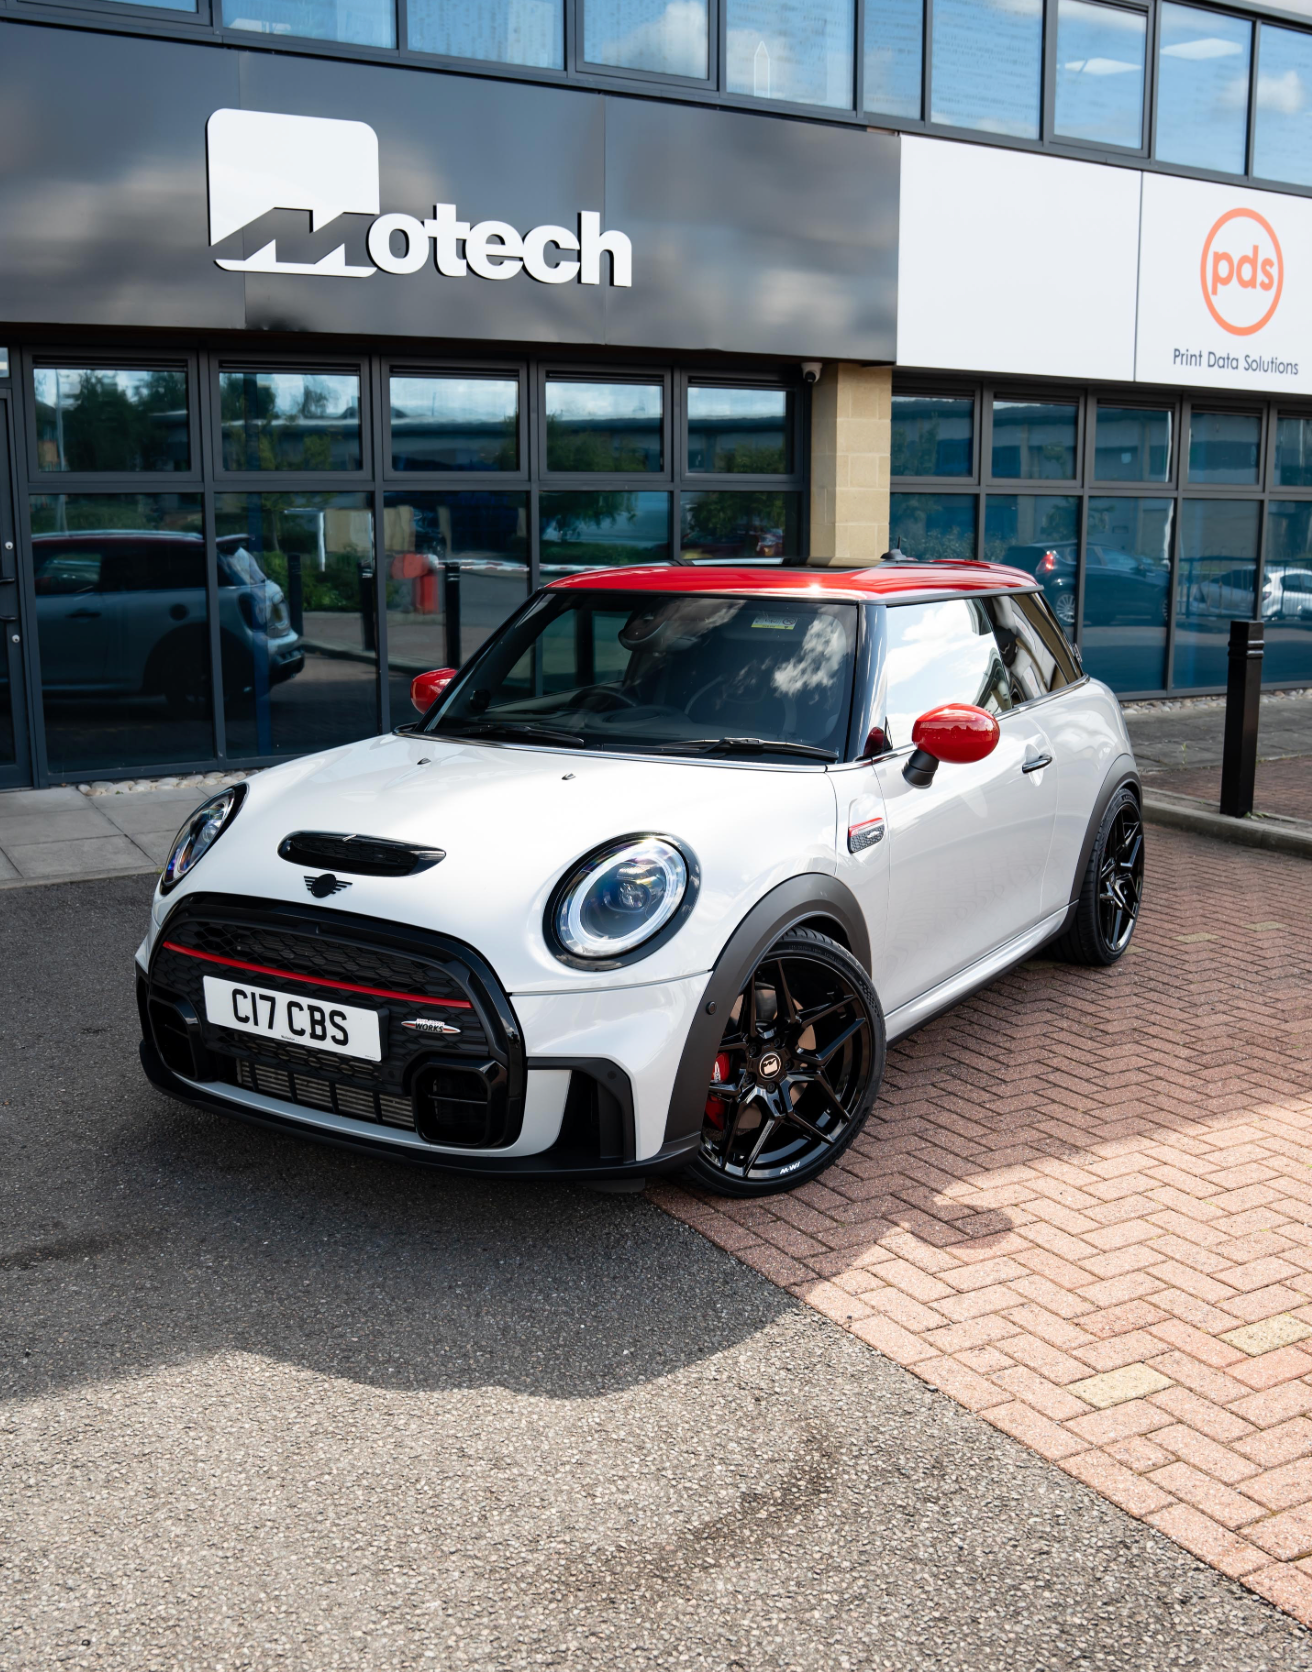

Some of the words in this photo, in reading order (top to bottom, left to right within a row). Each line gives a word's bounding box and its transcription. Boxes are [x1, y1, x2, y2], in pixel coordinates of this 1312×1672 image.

[1211, 244, 1275, 296] pds
[1173, 348, 1203, 367] Print
[1207, 351, 1239, 370] Data
[1243, 354, 1299, 375] Solutions
[232, 988, 277, 1030] C17
[287, 1000, 349, 1046] CBS
[415, 1022, 444, 1033] WORKS
